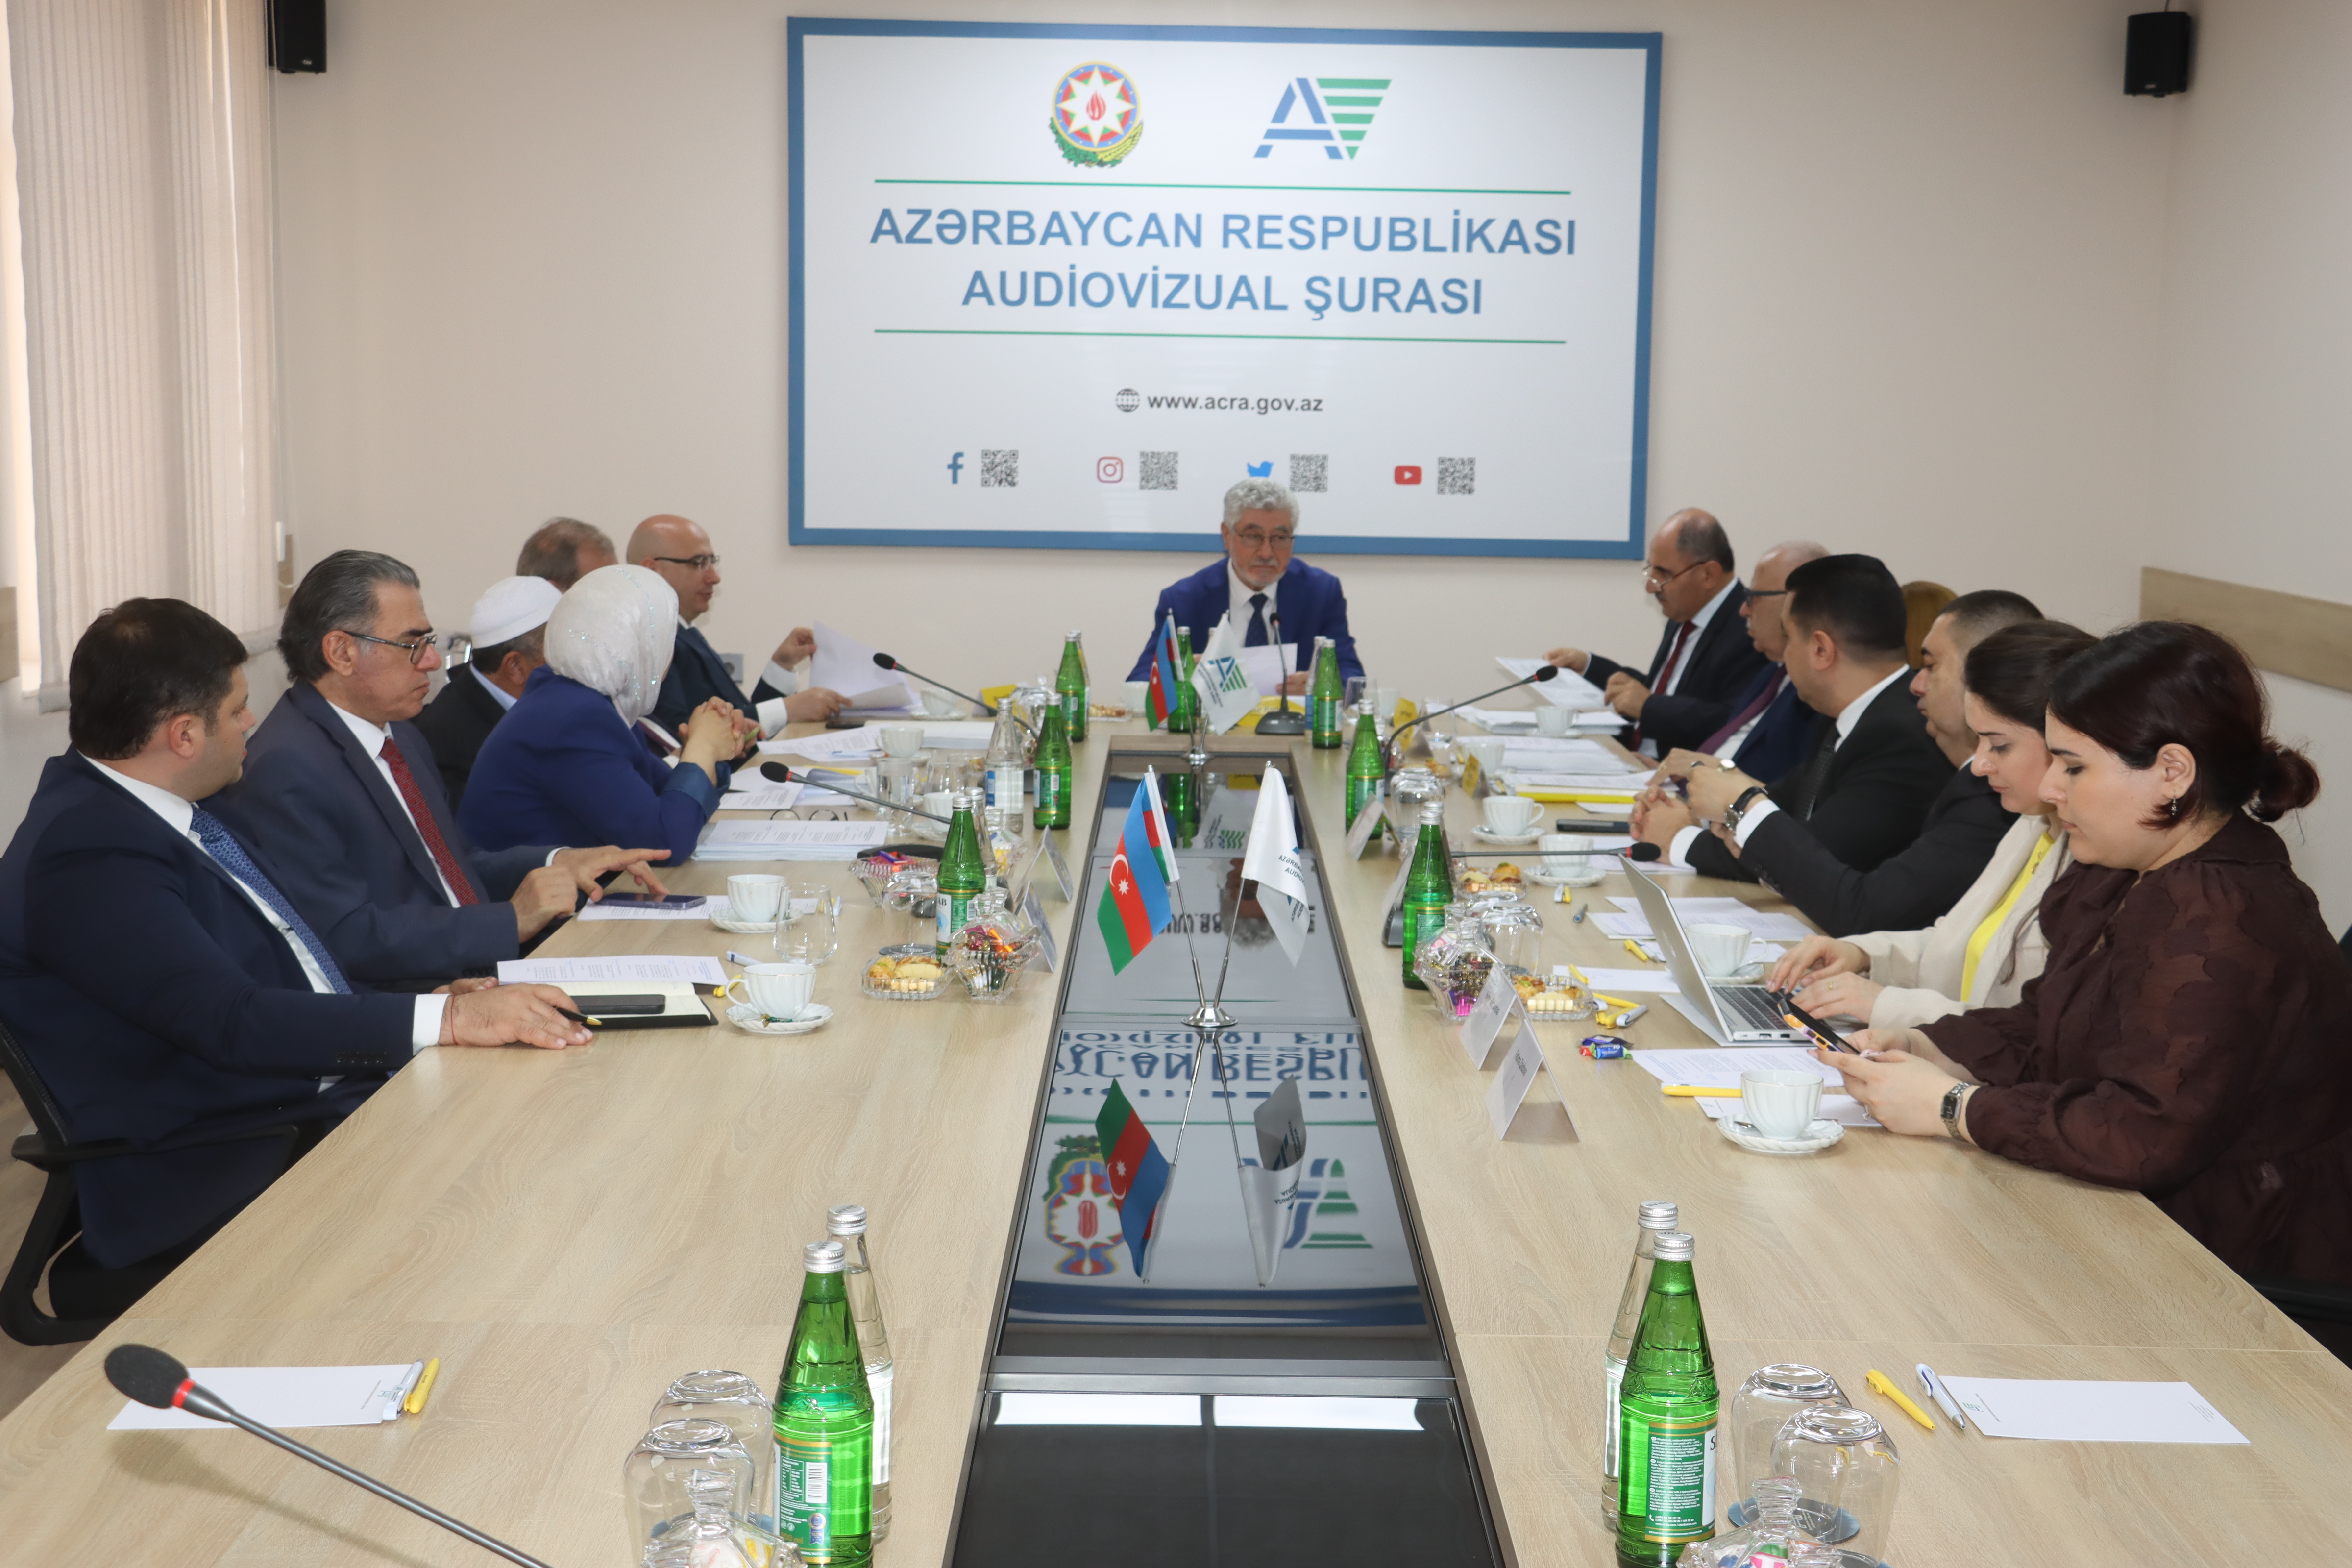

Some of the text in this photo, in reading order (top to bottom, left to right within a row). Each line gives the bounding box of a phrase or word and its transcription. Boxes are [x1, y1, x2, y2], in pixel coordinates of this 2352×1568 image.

[870, 208, 1576, 255] AZƏRBAYCAN RESPUBLİKASI
[961, 263, 1482, 321] AUDİOVİZUAL ŞURASI
[1147, 396, 1323, 415] www.acra.gov.az
